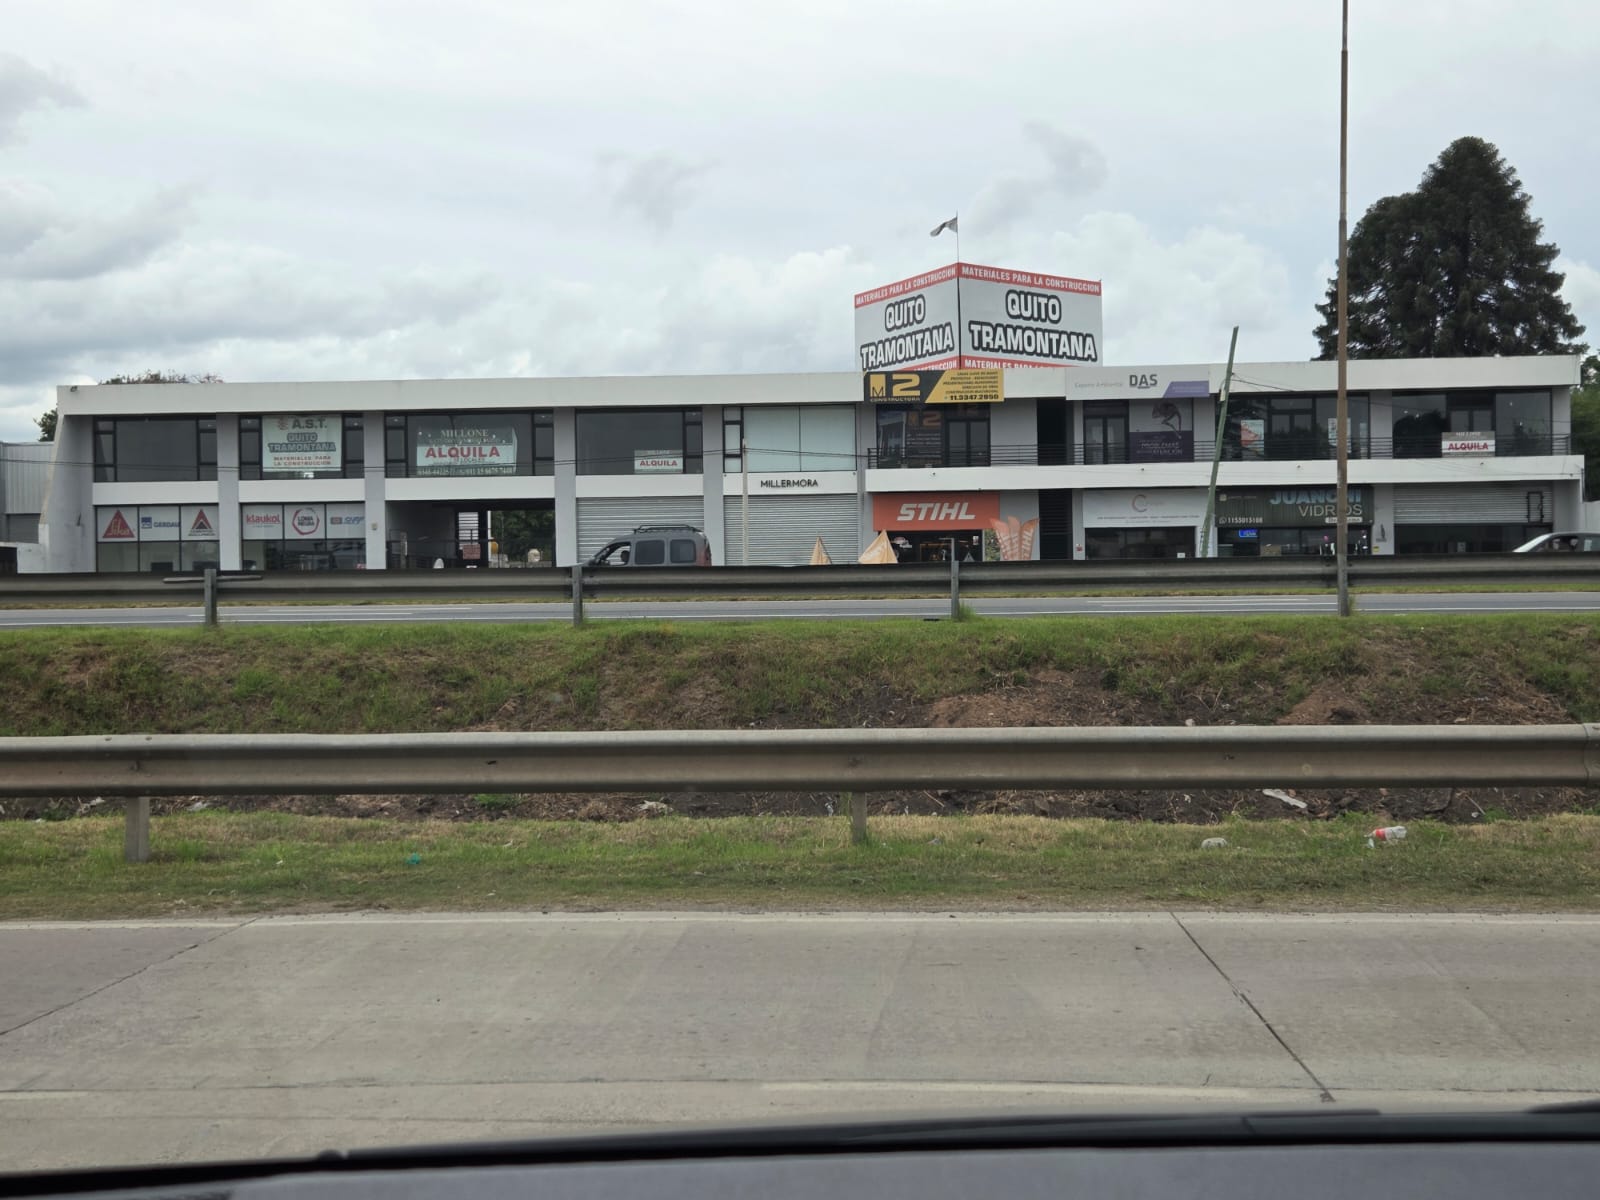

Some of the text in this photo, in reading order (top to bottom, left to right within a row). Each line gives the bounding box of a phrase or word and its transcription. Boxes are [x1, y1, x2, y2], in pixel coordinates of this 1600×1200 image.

[856, 268, 955, 304] MATERIALES PARA LA CONSTRUCCION
[962, 266, 1100, 292] MATERIALES PARA LA CONSTRUCCION
[885, 294, 926, 332] QUITO
[1006, 290, 1062, 324] QUITO
[860, 321, 954, 370] TRAMONTANA
[969, 320, 1097, 362] TRAMONTANA
[892, 374, 920, 396] 2
[1129, 374, 1158, 388] DAS
[287, 432, 318, 442] QUITO
[268, 442, 336, 453] TRAMONTANA
[425, 447, 500, 458] ALQUILA
[761, 479, 818, 488] MILLERMORA
[246, 514, 280, 524] klaukol
[897, 502, 976, 521] STIHL
